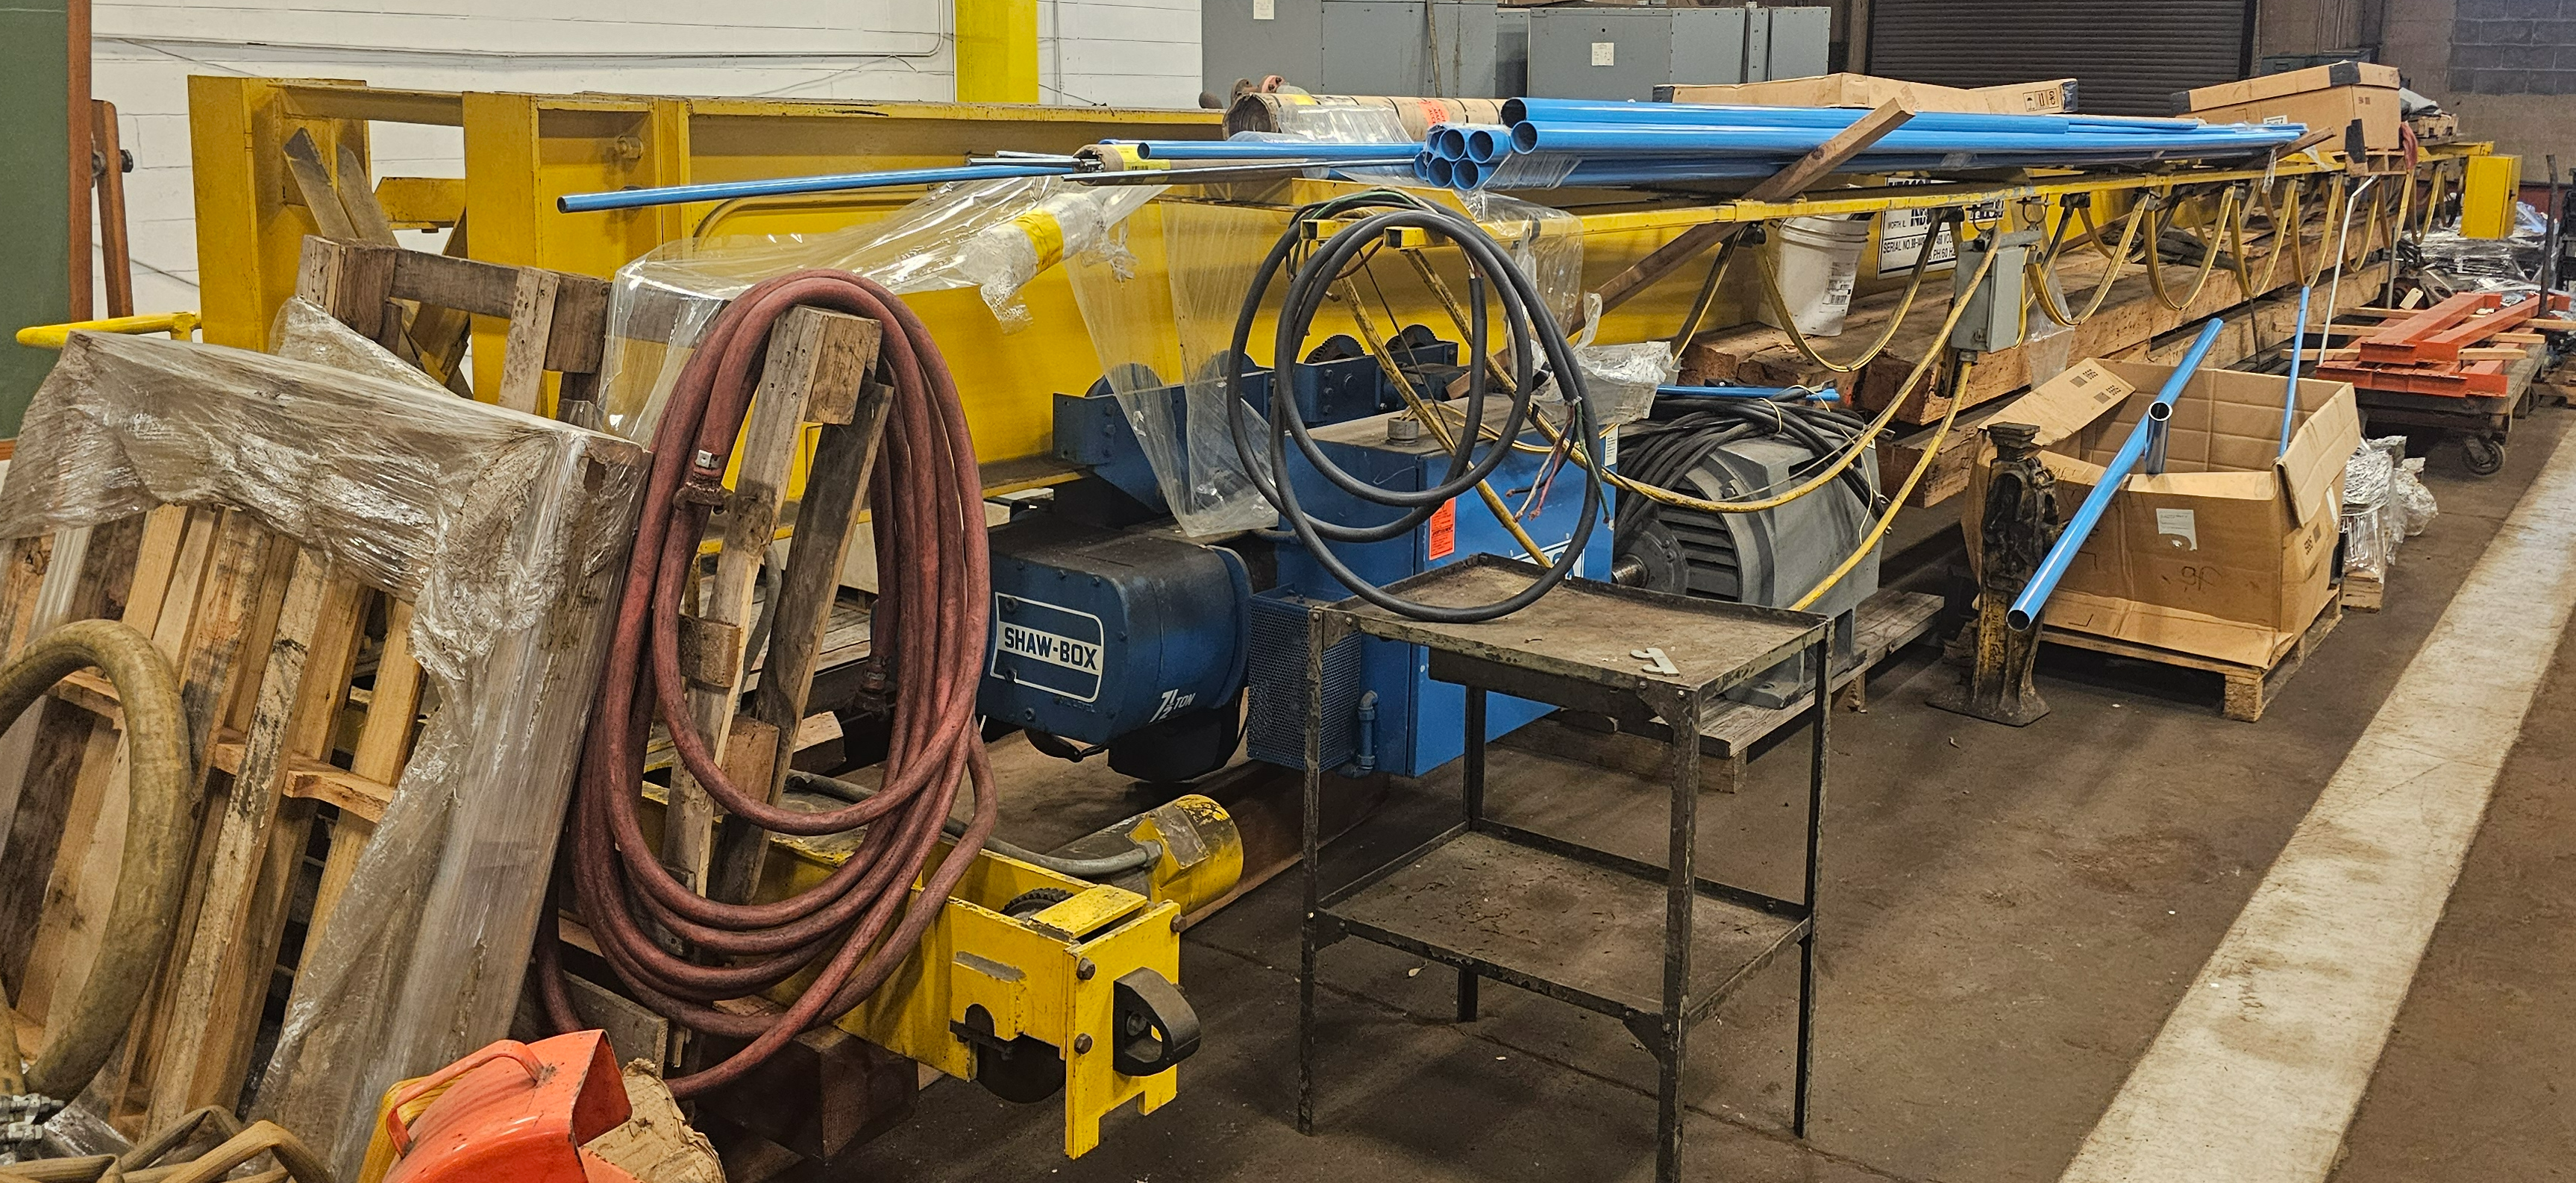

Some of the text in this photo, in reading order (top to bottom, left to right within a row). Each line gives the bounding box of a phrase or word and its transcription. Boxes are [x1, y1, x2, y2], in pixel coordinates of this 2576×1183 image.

[1883, 240, 1902, 254] SERIAL
[1933, 248, 1941, 260] PH
[1941, 247, 1949, 259] 60
[1004, 627, 1097, 671] SHAW-BOX
[1173, 693, 1197, 709] TON
